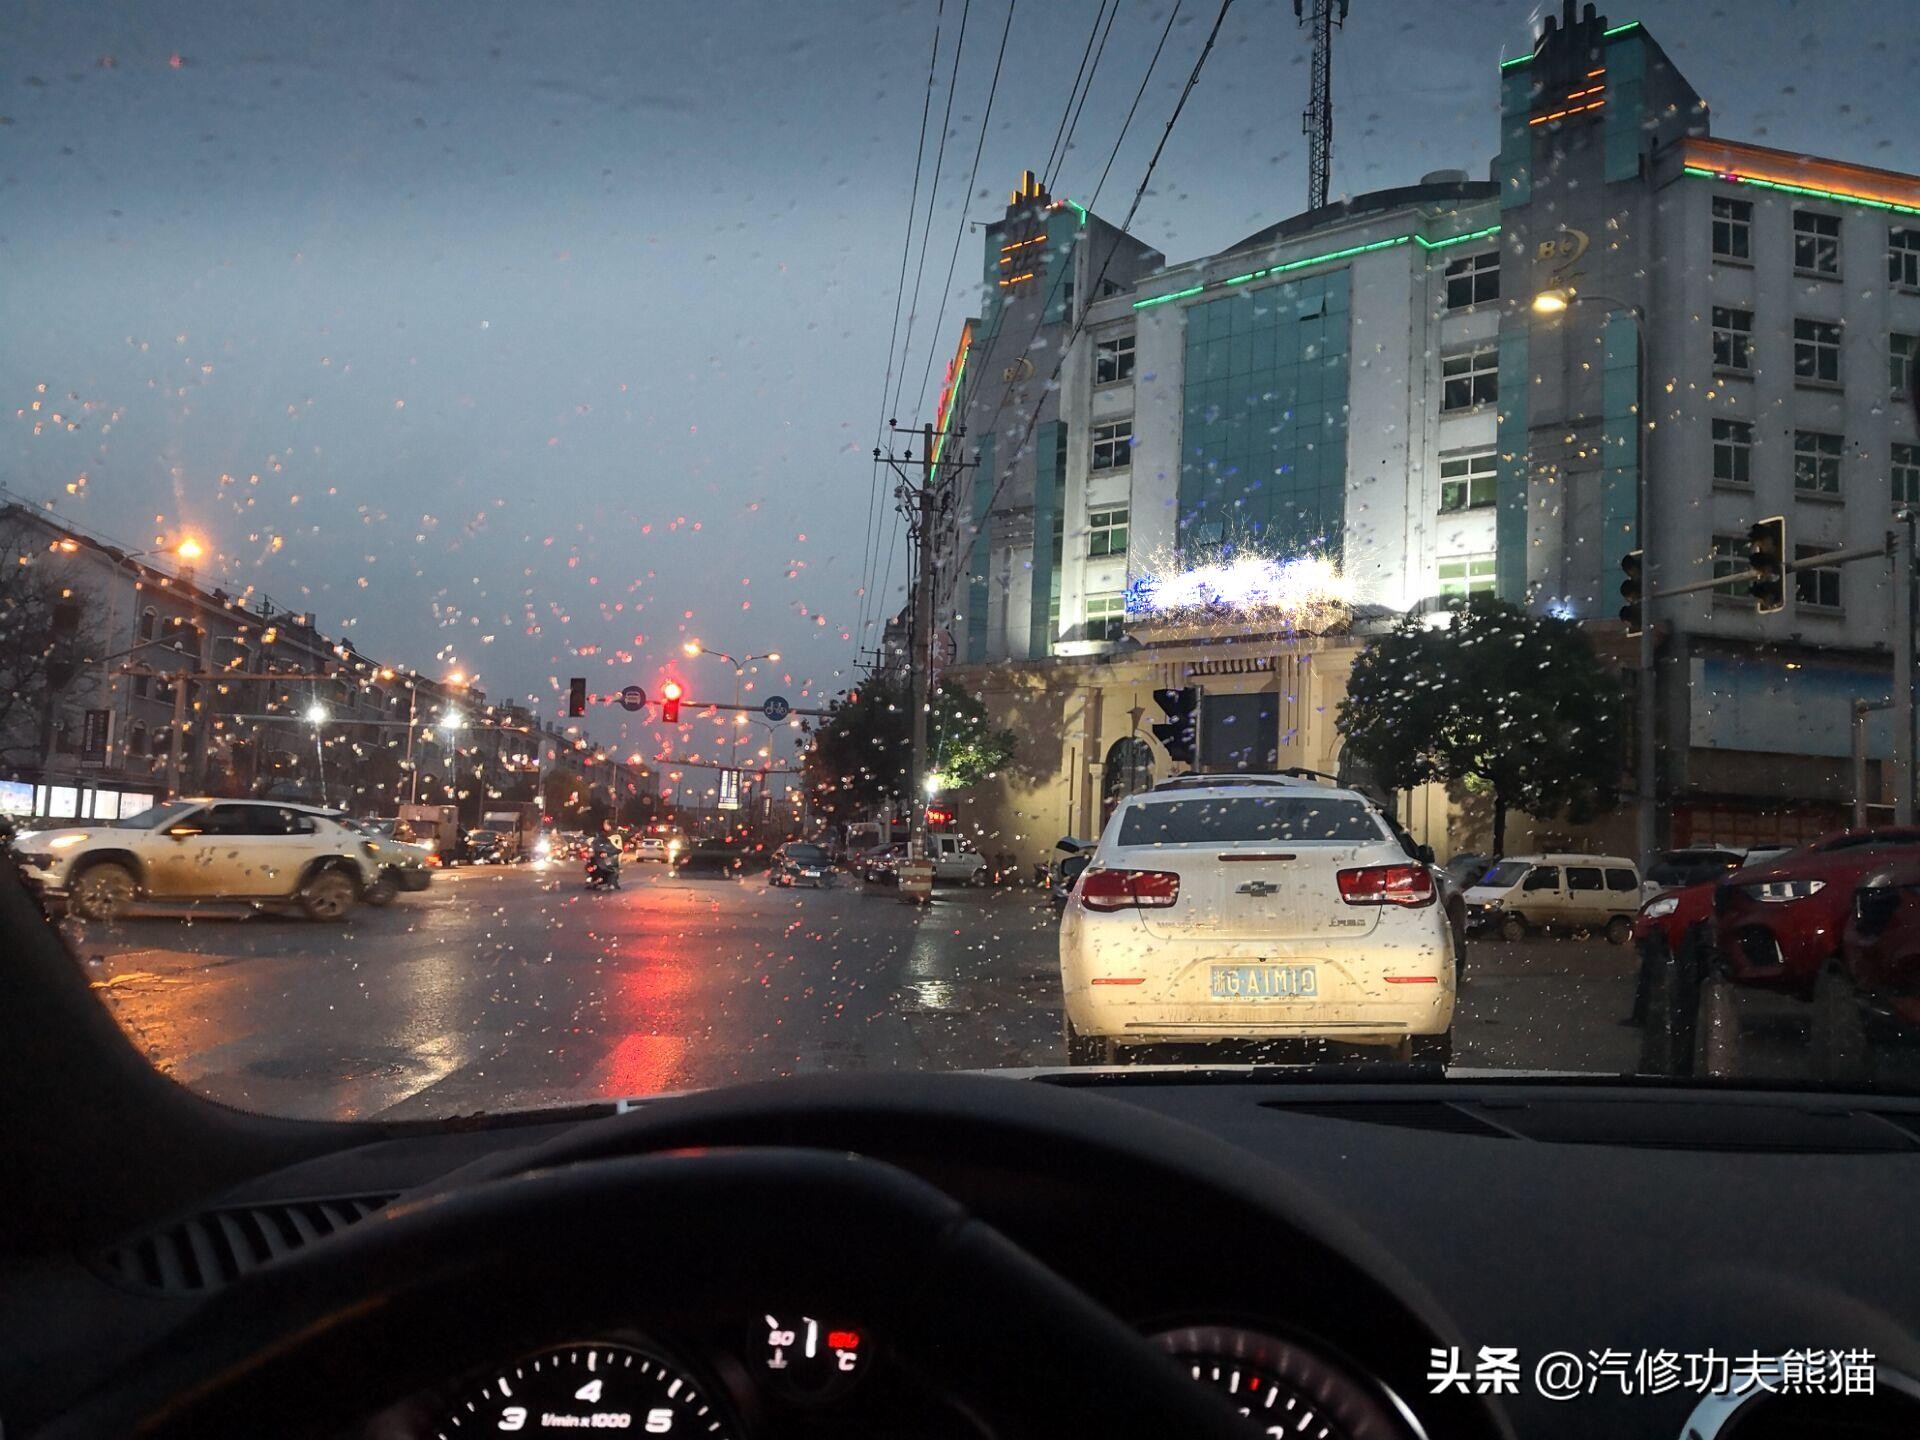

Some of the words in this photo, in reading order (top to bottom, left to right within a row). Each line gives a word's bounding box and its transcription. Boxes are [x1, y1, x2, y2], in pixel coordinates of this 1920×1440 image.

[575, 1379, 602, 1403] 4
[498, 1407, 527, 1431] 3
[645, 1409, 673, 1433] 5
